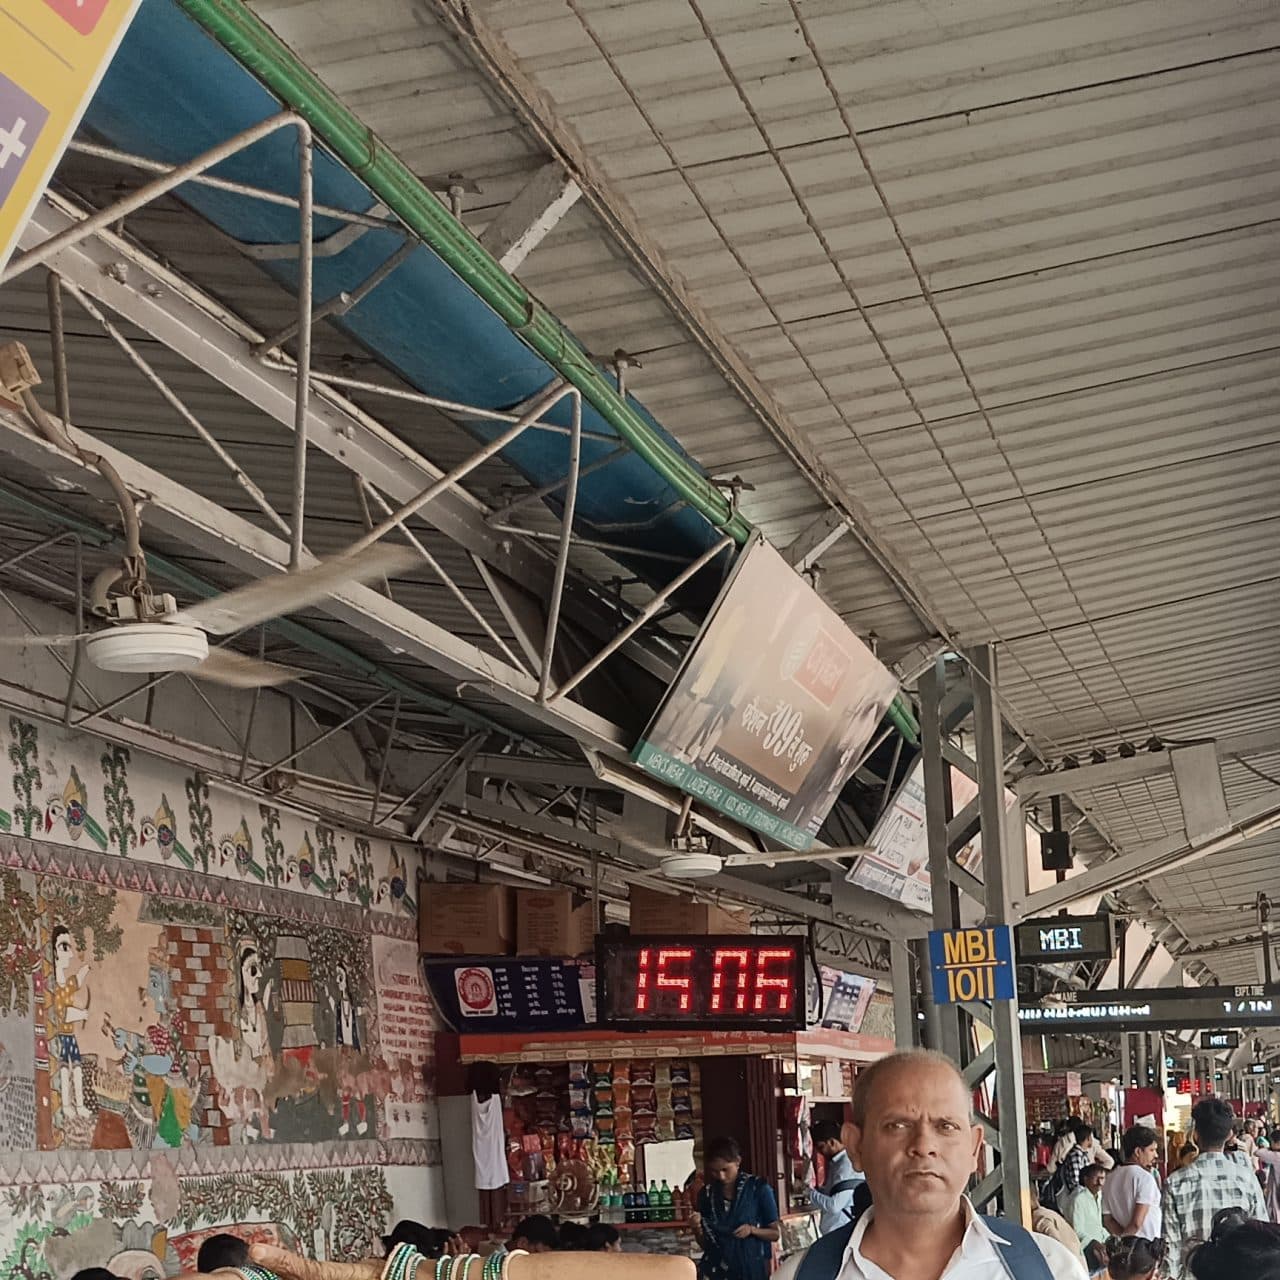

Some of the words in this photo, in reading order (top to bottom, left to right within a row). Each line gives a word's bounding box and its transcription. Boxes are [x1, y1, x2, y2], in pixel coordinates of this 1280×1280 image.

[665, 764, 686, 780] WEAR
[705, 785, 723, 801] WEAR
[735, 802, 751, 818] WEAR
[943, 928, 997, 964] MBI
[1039, 927, 1083, 950] MBI
